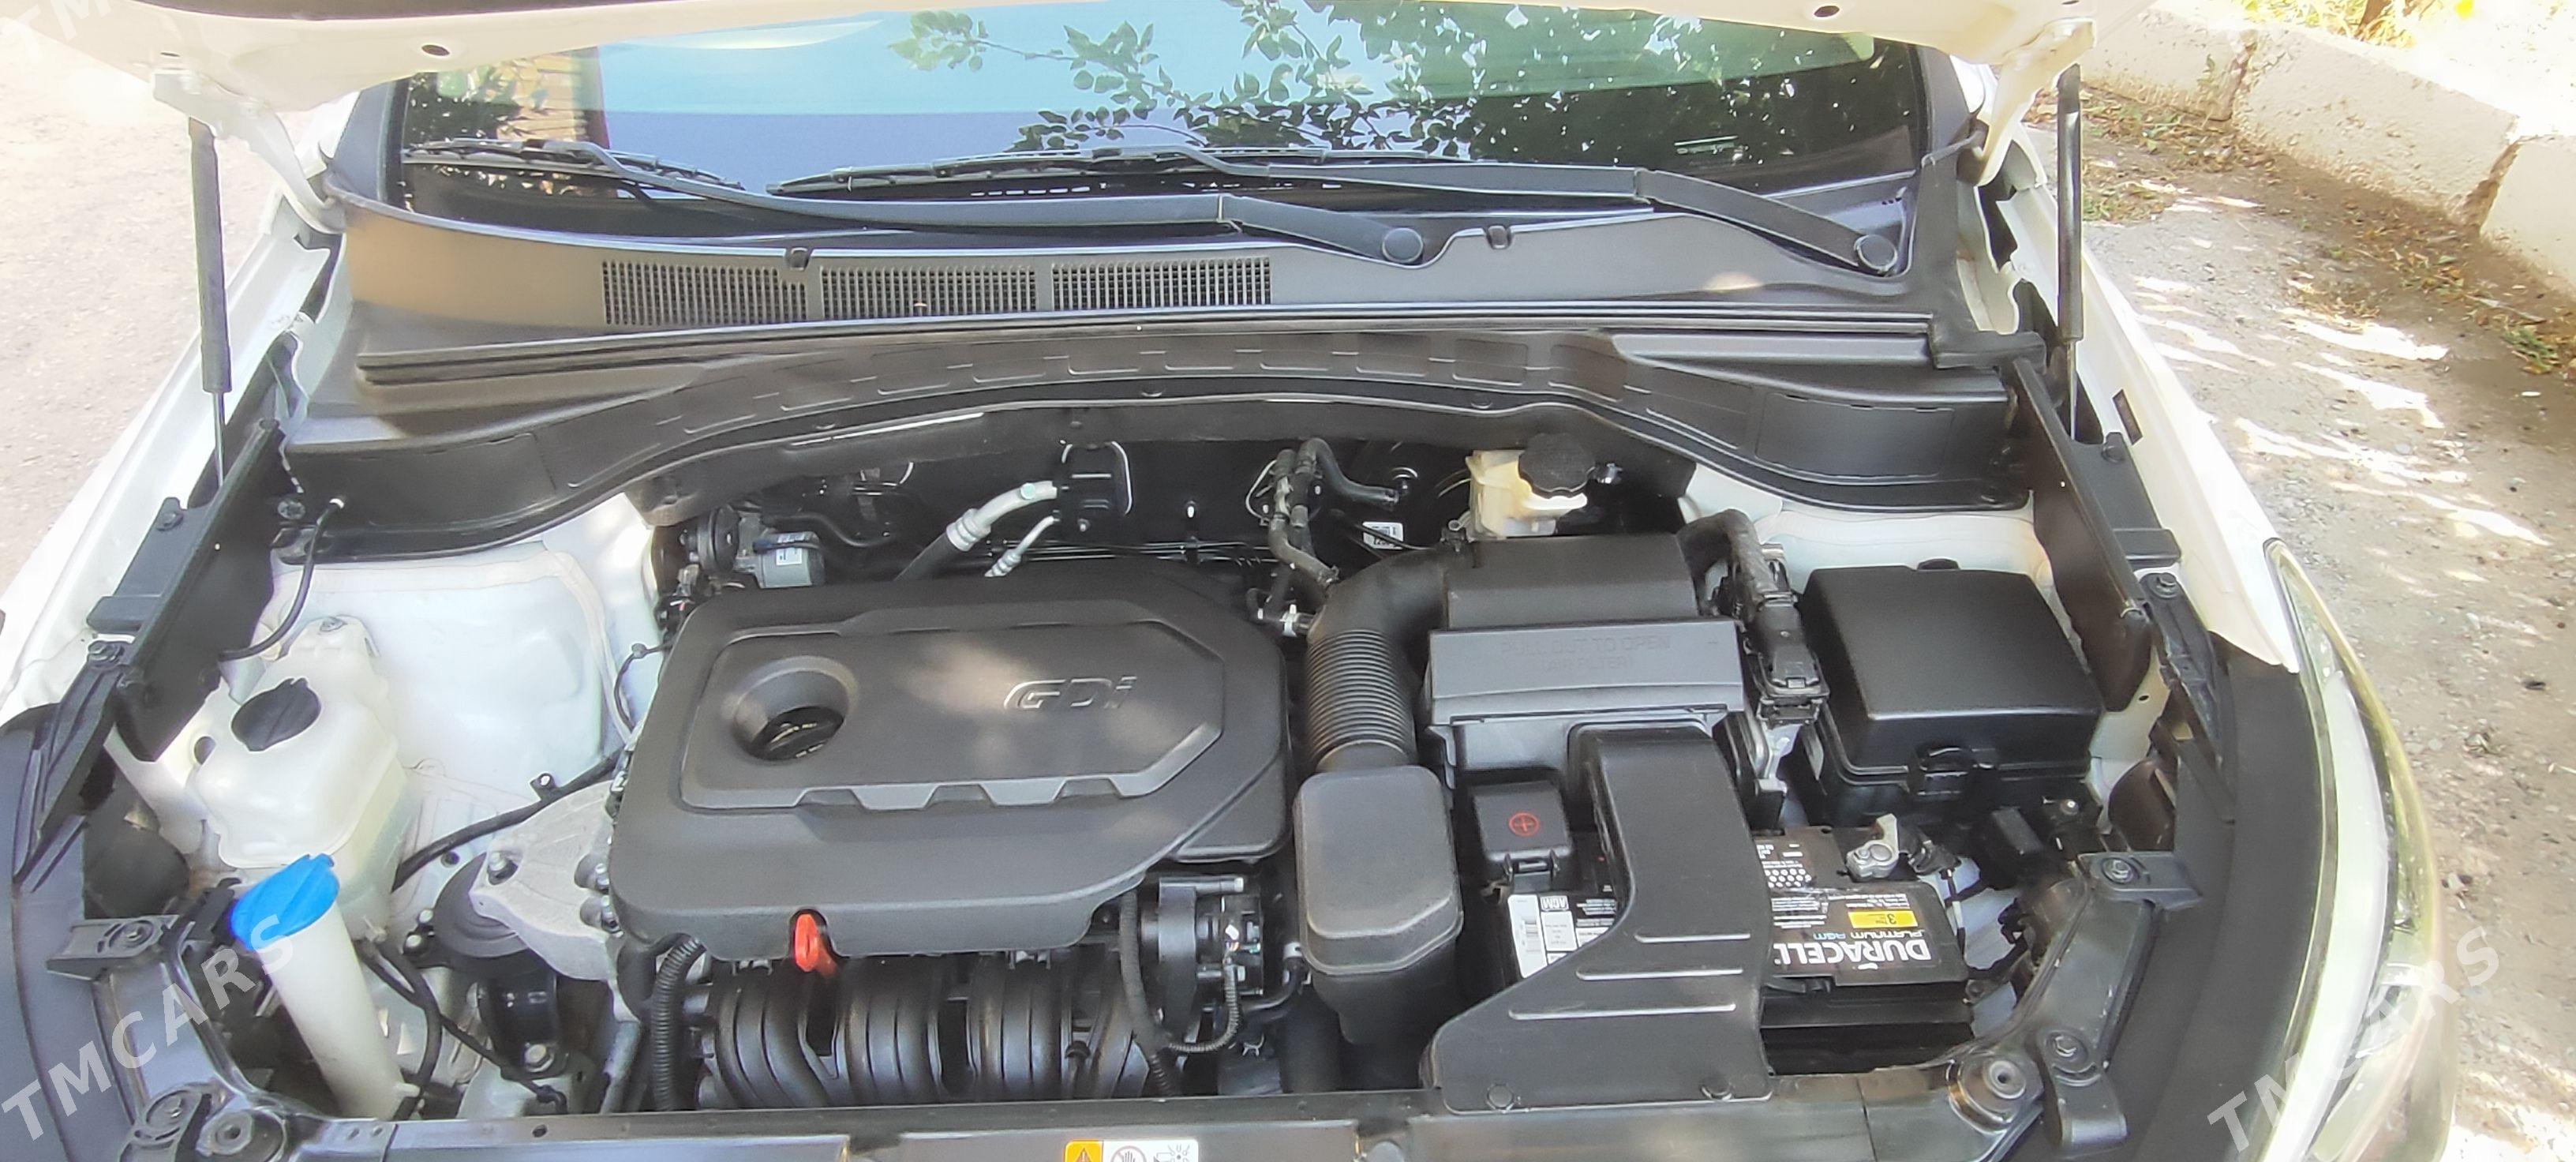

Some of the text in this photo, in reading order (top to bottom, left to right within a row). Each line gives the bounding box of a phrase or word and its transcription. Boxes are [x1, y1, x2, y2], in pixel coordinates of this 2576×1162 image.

[1591, 636, 1616, 652] TO
[1621, 634, 1671, 651] OPEN
[1887, 913, 1897, 925] 3
[1773, 939, 1932, 965] DURACELL
